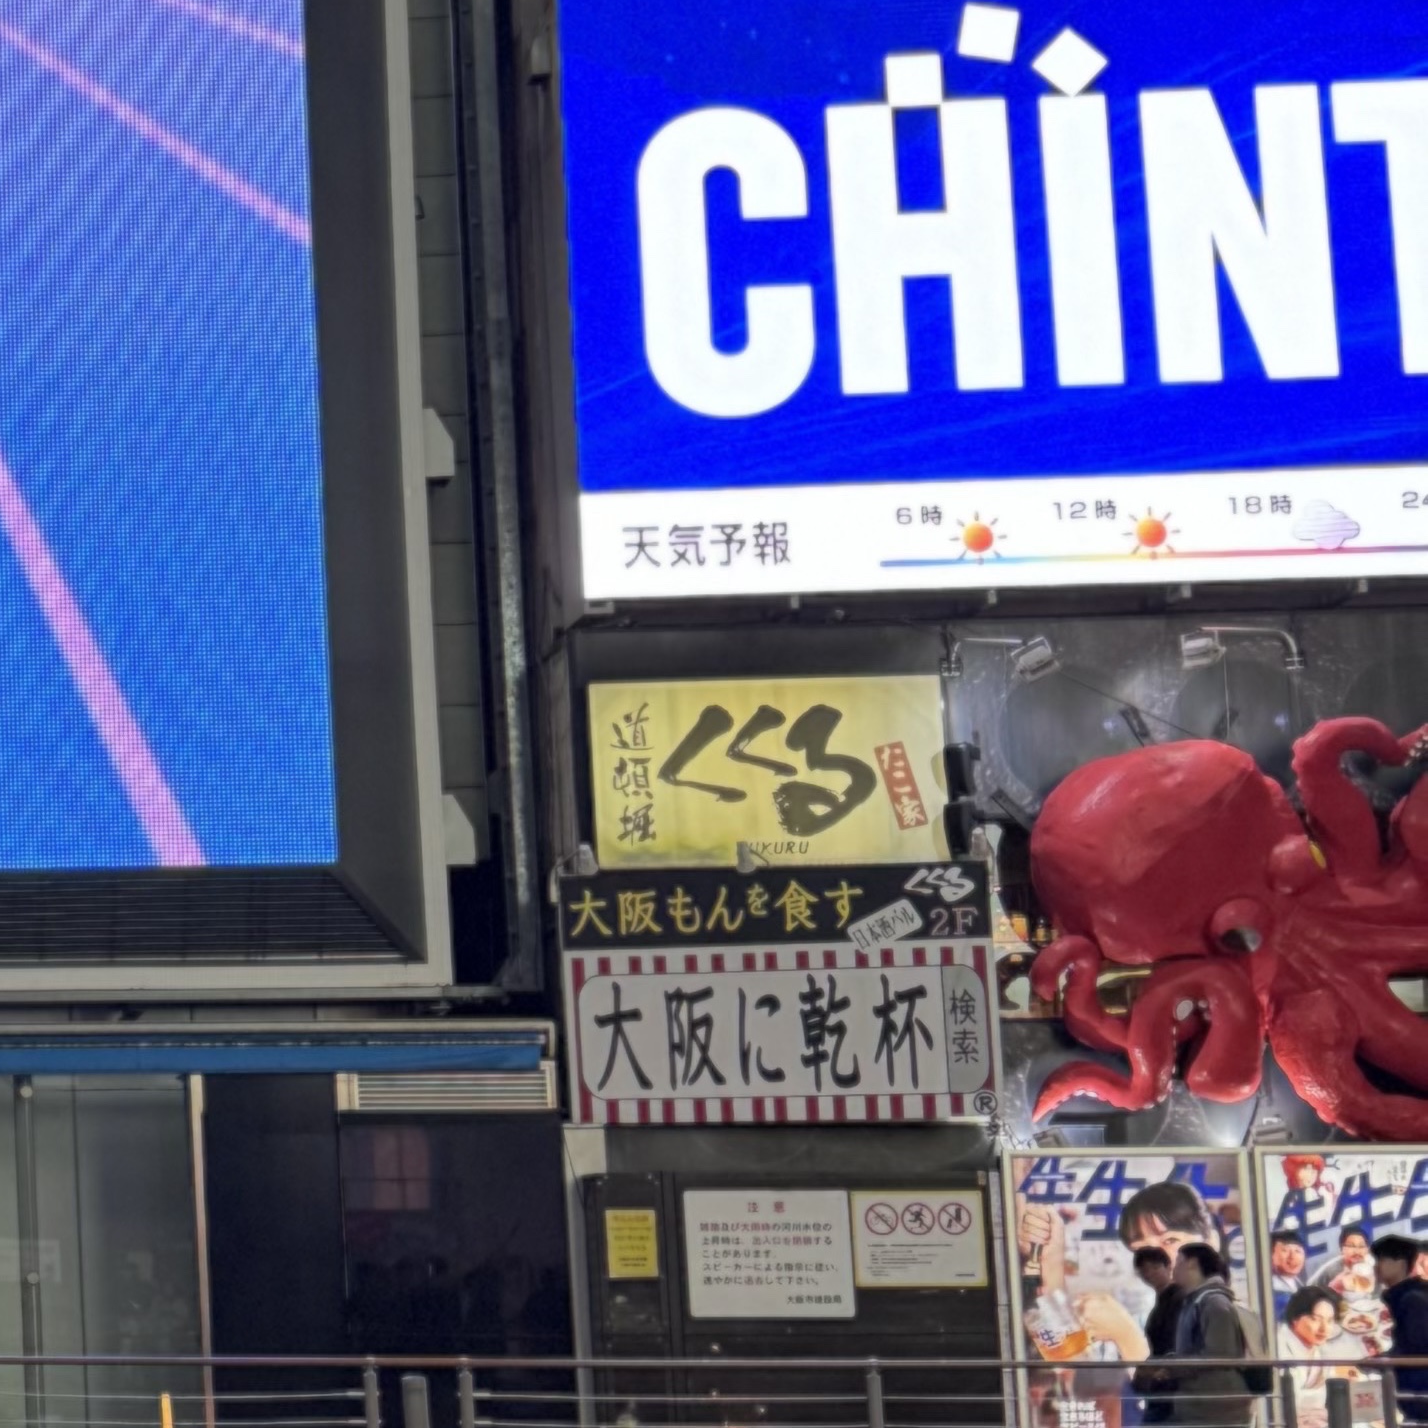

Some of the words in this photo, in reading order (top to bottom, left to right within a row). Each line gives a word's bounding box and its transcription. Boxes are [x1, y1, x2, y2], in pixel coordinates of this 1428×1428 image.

[623, 522, 791, 570] 天気予報
[658, 703, 877, 837] くくる
[568, 878, 864, 939] 大阪もんを食す
[929, 906, 979, 936] 2F
[593, 973, 934, 1093] 大阪に乾杯
[948, 988, 981, 1065] 検索
